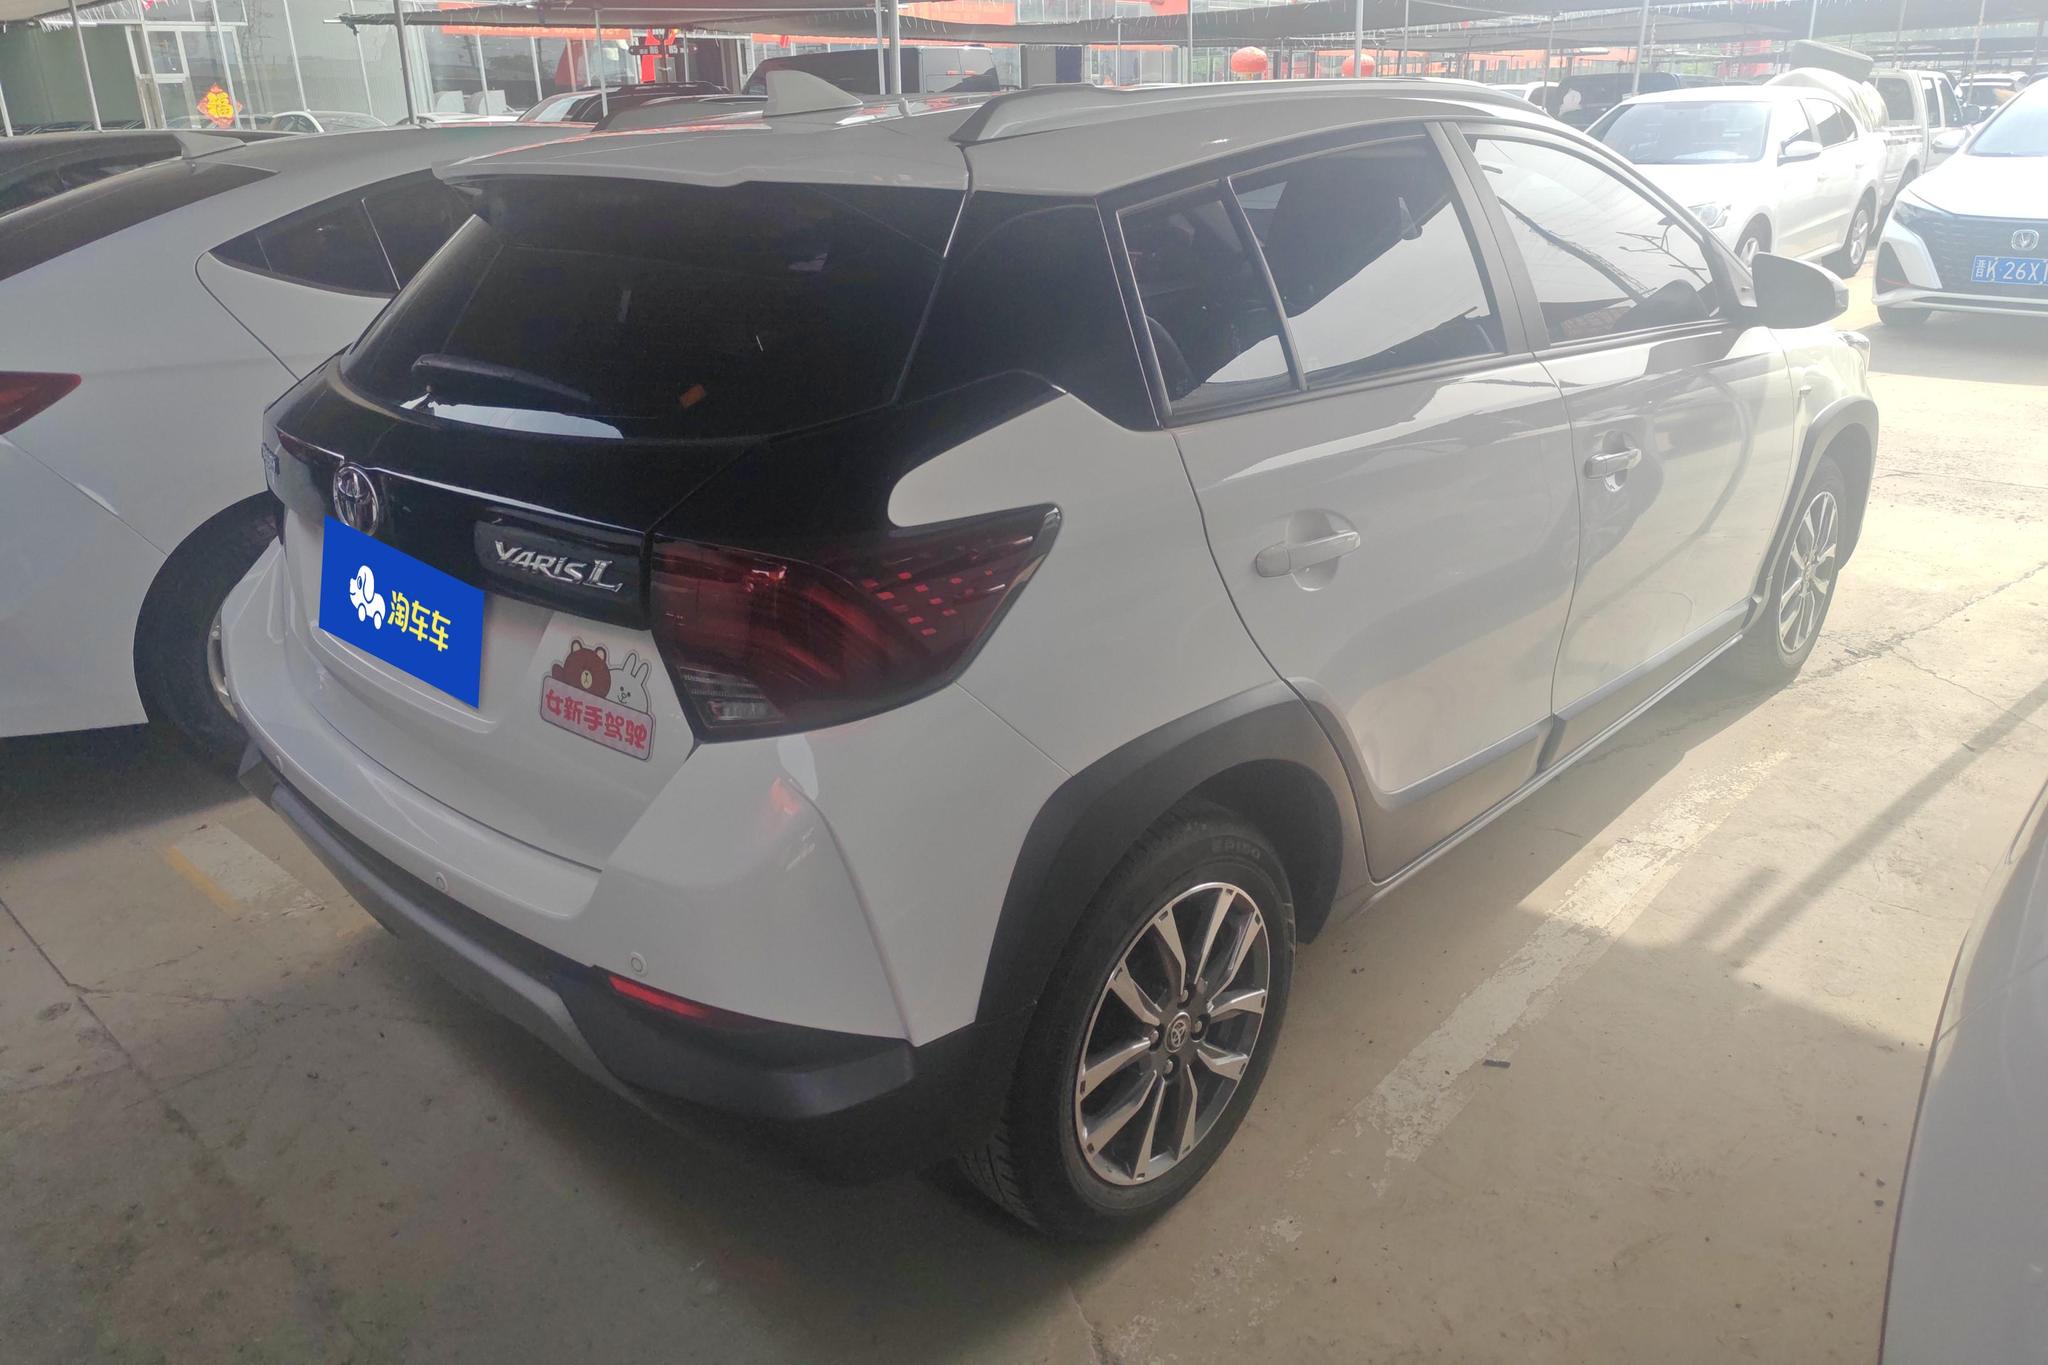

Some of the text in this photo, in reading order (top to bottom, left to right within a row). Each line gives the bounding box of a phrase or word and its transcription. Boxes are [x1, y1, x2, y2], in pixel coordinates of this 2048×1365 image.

[207, 92, 234, 119] 福
[546, 689, 648, 749] 女新手驾驶
